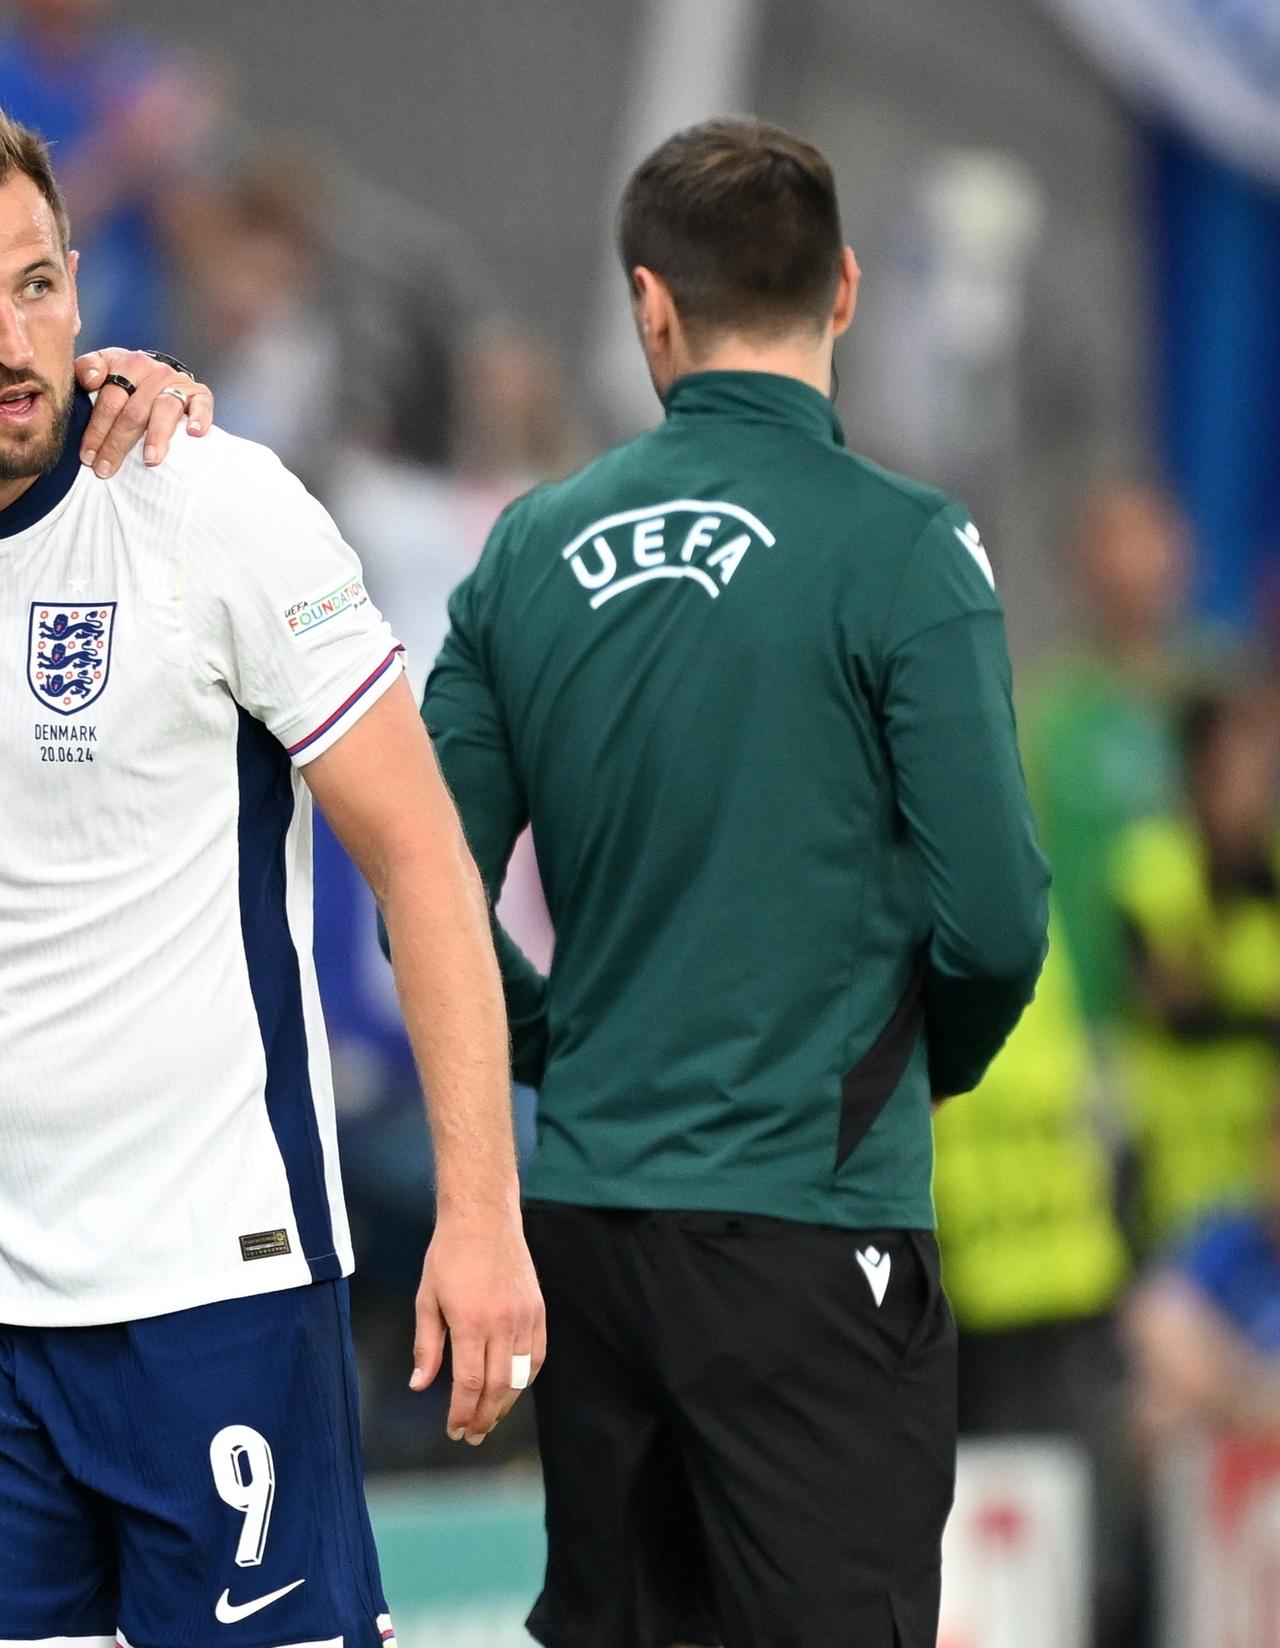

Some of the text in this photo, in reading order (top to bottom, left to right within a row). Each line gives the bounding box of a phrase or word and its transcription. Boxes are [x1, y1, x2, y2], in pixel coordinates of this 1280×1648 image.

[570, 516, 752, 589] UEFA
[284, 600, 309, 618] UEFA
[34, 723, 97, 741] DENMARK
[41, 746, 93, 763] 20.06.24
[210, 1424, 276, 1567] 9
